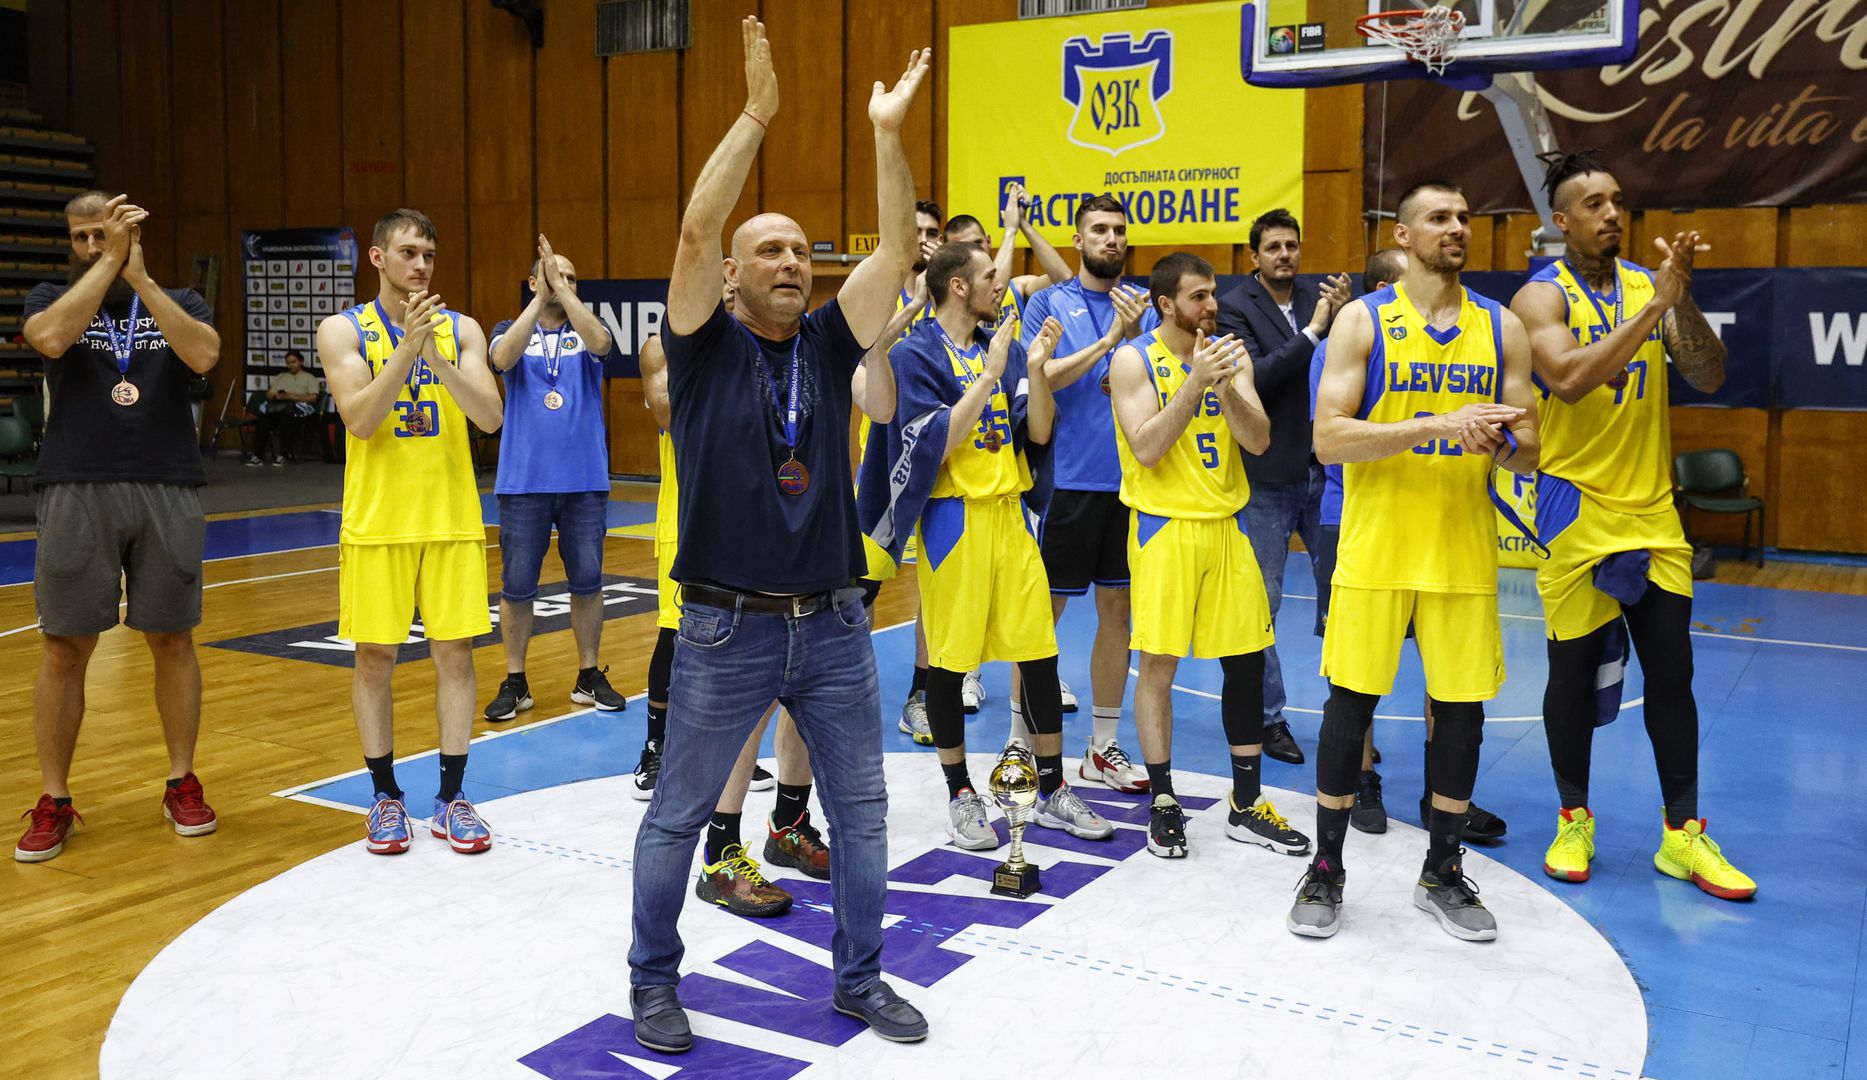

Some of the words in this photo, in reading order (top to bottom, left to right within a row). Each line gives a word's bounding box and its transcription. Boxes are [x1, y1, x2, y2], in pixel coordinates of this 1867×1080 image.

[1301, 25, 1322, 38] FIBA
[1090, 78, 1141, 135] ОЗК
[1643, 92, 1711, 153] la
[1723, 84, 1854, 149] vita
[1104, 169, 1175, 187] ДОСТЪПНАТА
[1177, 167, 1240, 182] СИГУРНОСТ
[790, 368, 798, 410] НАЦИОНАЛНА
[1389, 361, 1495, 397] LEVSKI
[394, 400, 440, 437] 30
[1196, 432, 1220, 469] 5
